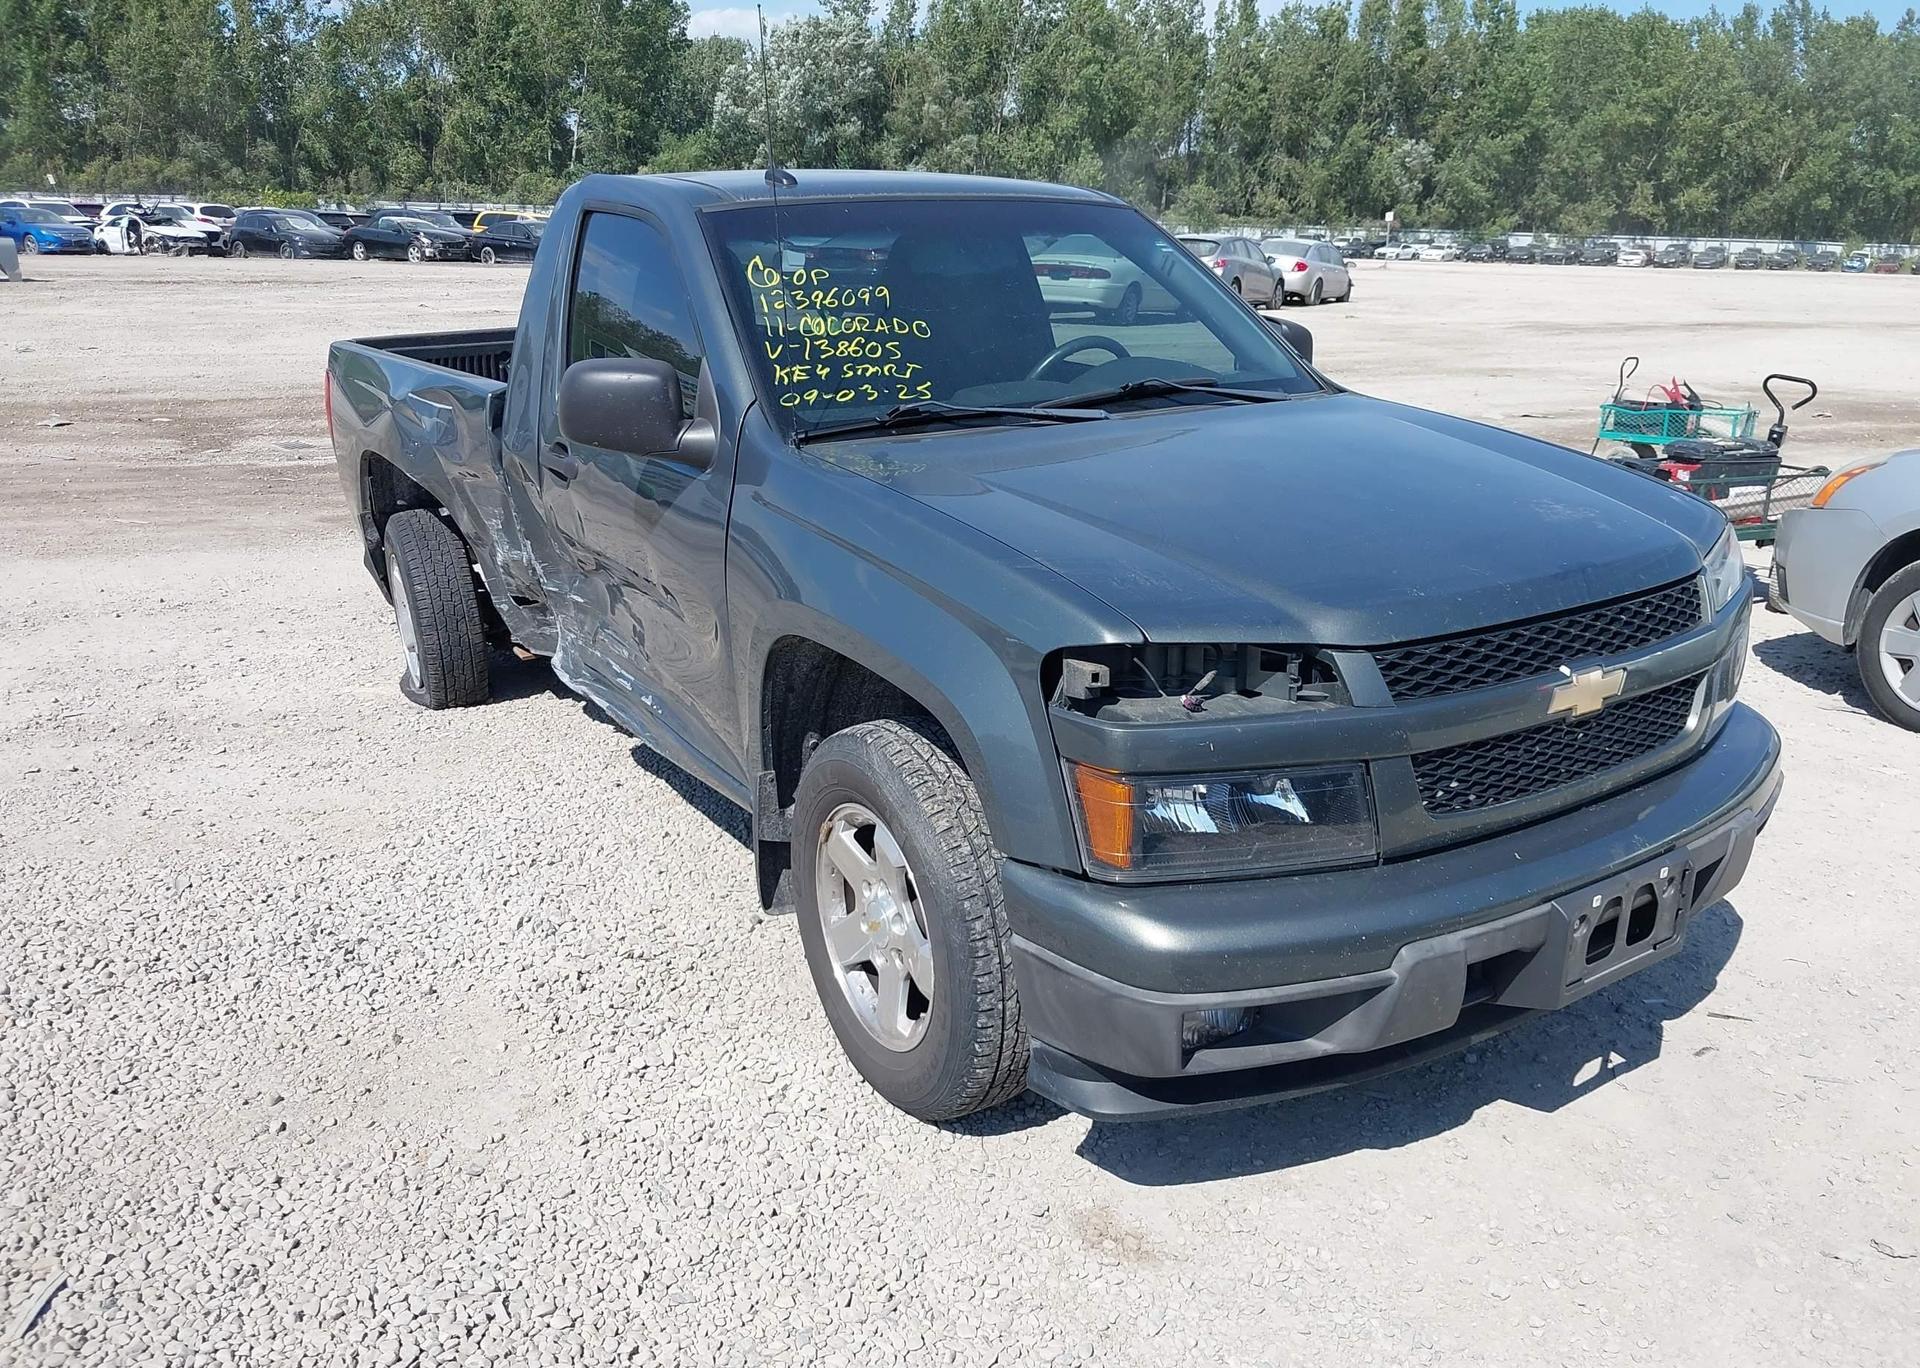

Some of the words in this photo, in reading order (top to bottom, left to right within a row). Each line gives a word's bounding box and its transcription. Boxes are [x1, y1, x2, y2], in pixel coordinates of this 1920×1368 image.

[760, 287, 890, 313] 12396099
[774, 364, 830, 385] KEY
[841, 363, 923, 379] START
